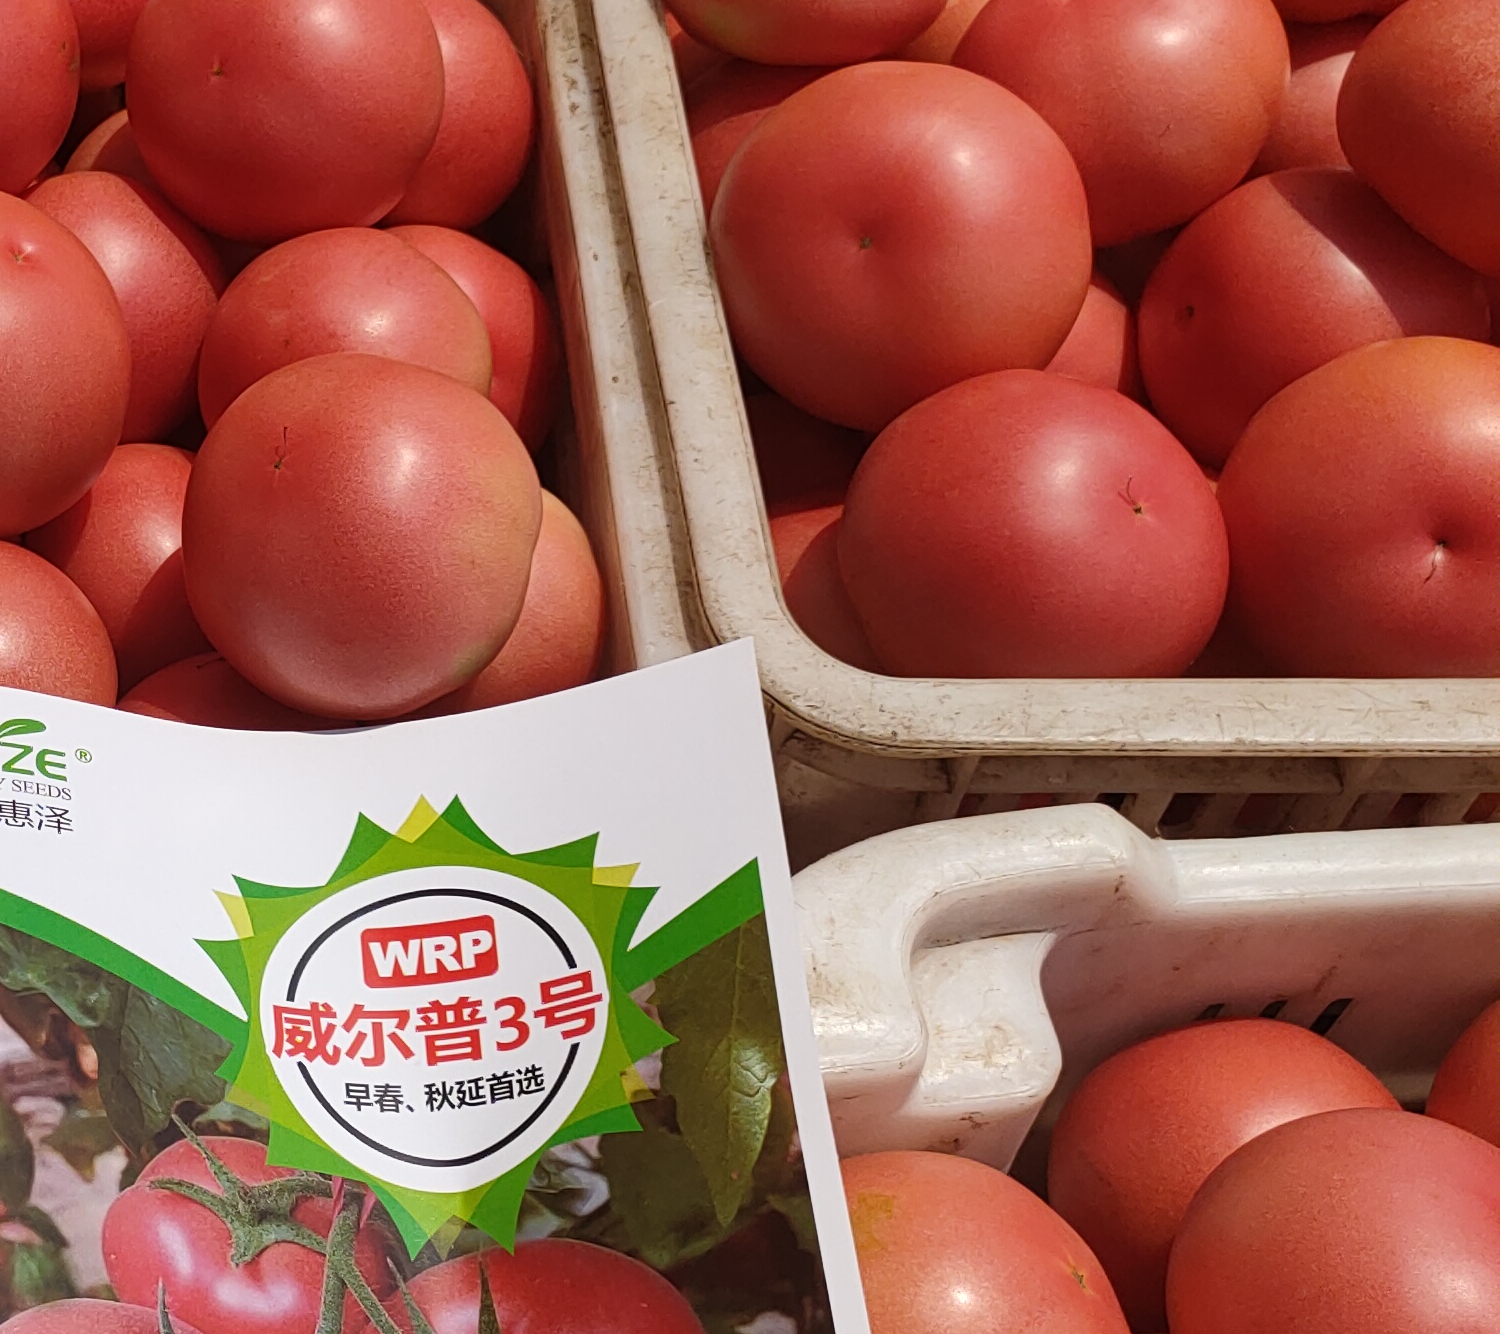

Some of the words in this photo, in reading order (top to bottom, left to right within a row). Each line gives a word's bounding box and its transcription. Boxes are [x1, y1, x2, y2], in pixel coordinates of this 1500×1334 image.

[11, 778, 73, 801] SEEDS
[367, 929, 494, 979] WRP
[271, 969, 603, 1068] 威尔普3号
[343, 1064, 546, 1114] 早春、秋延首选
